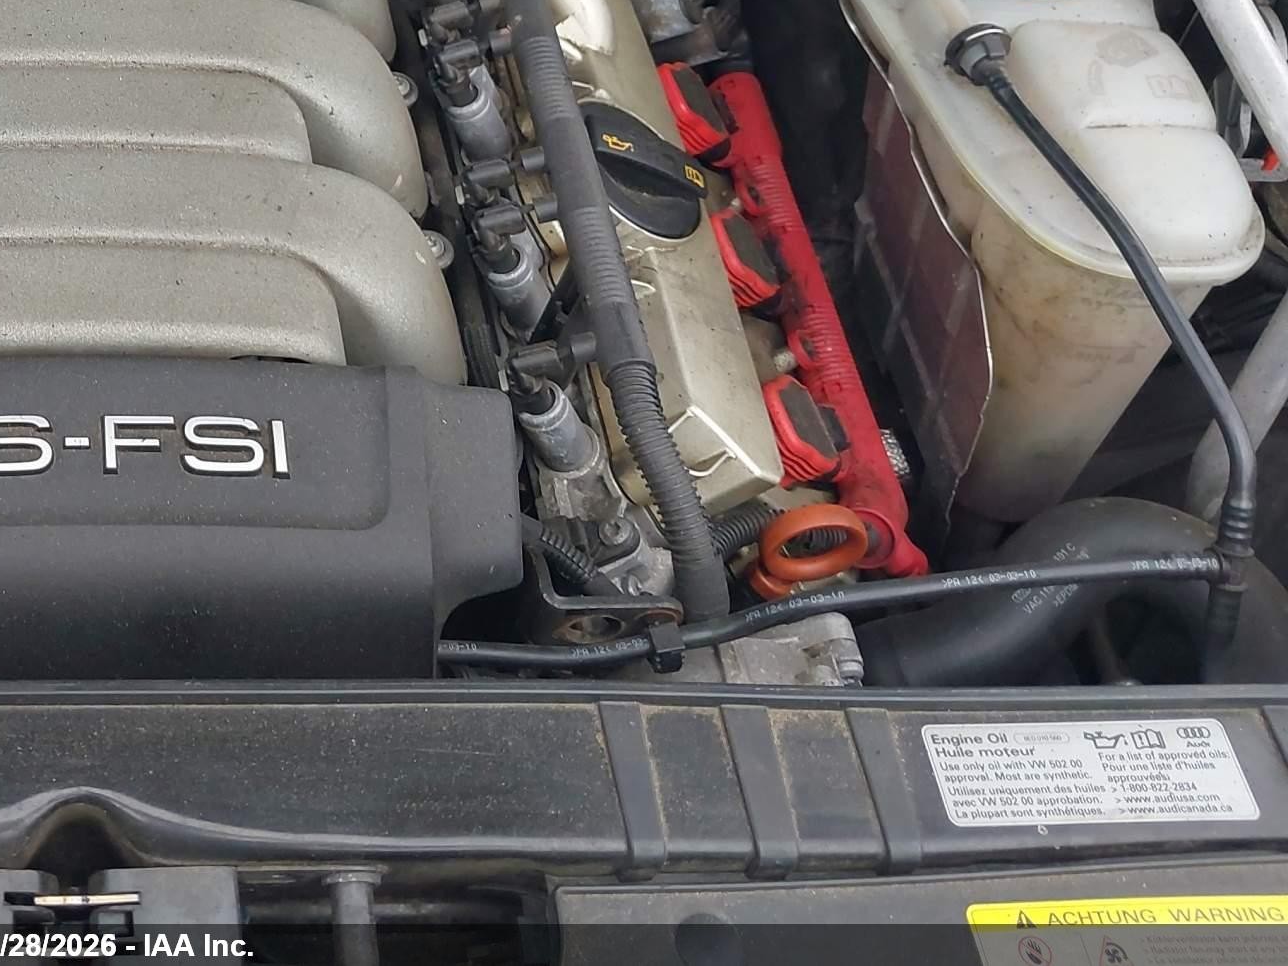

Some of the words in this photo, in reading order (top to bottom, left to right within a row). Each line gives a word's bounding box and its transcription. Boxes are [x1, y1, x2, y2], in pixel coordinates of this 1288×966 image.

[930, 733, 983, 747] Engine
[987, 732, 1008, 745] Oil
[934, 746, 974, 758] Huile
[978, 745, 1036, 757] moteur
[1098, 751, 1117, 762] For
[1119, 753, 1127, 761] a
[1127, 751, 1143, 762] list
[1146, 750, 1157, 761] of
[1158, 749, 1208, 762] approved
[939, 760, 961, 772] Use
[962, 760, 985, 773] only
[987, 759, 1002, 771] oil
[1002, 759, 1027, 770] with
[1027, 759, 1047, 770] VW
[1048, 758, 1069, 769] 502
[1069, 758, 1083, 769] 00
[1101, 762, 1128, 773] Pour
[1129, 763, 1150, 772] une
[1150, 760, 1173, 772] liste
[944, 771, 994, 784] approval.
[994, 771, 1022, 782] Most
[1024, 773, 1042, 781] are
[1043, 769, 1093, 782] synthetic.
[947, 785, 987, 797] Utilisez
[988, 784, 1053, 799] uniquement
[1053, 783, 1074, 795] des
[1073, 782, 1106, 794] huiles
[1120, 781, 1198, 793] 1-800-822-2834
[952, 799, 978, 808] avec
[977, 796, 998, 807] VW
[999, 796, 1020, 807] 502
[1020, 795, 1034, 806] 00
[1036, 794, 1103, 807] approbation.
[1123, 792, 1221, 804] www.audiusa.com
[954, 809, 970, 819] La
[971, 807, 1010, 821] plupart
[1010, 807, 1034, 818] sont
[1127, 803, 1233, 814] www.audicanada.ca
[1047, 909, 1157, 926] ACHTUNG
[1167, 906, 1285, 923] WARNING
